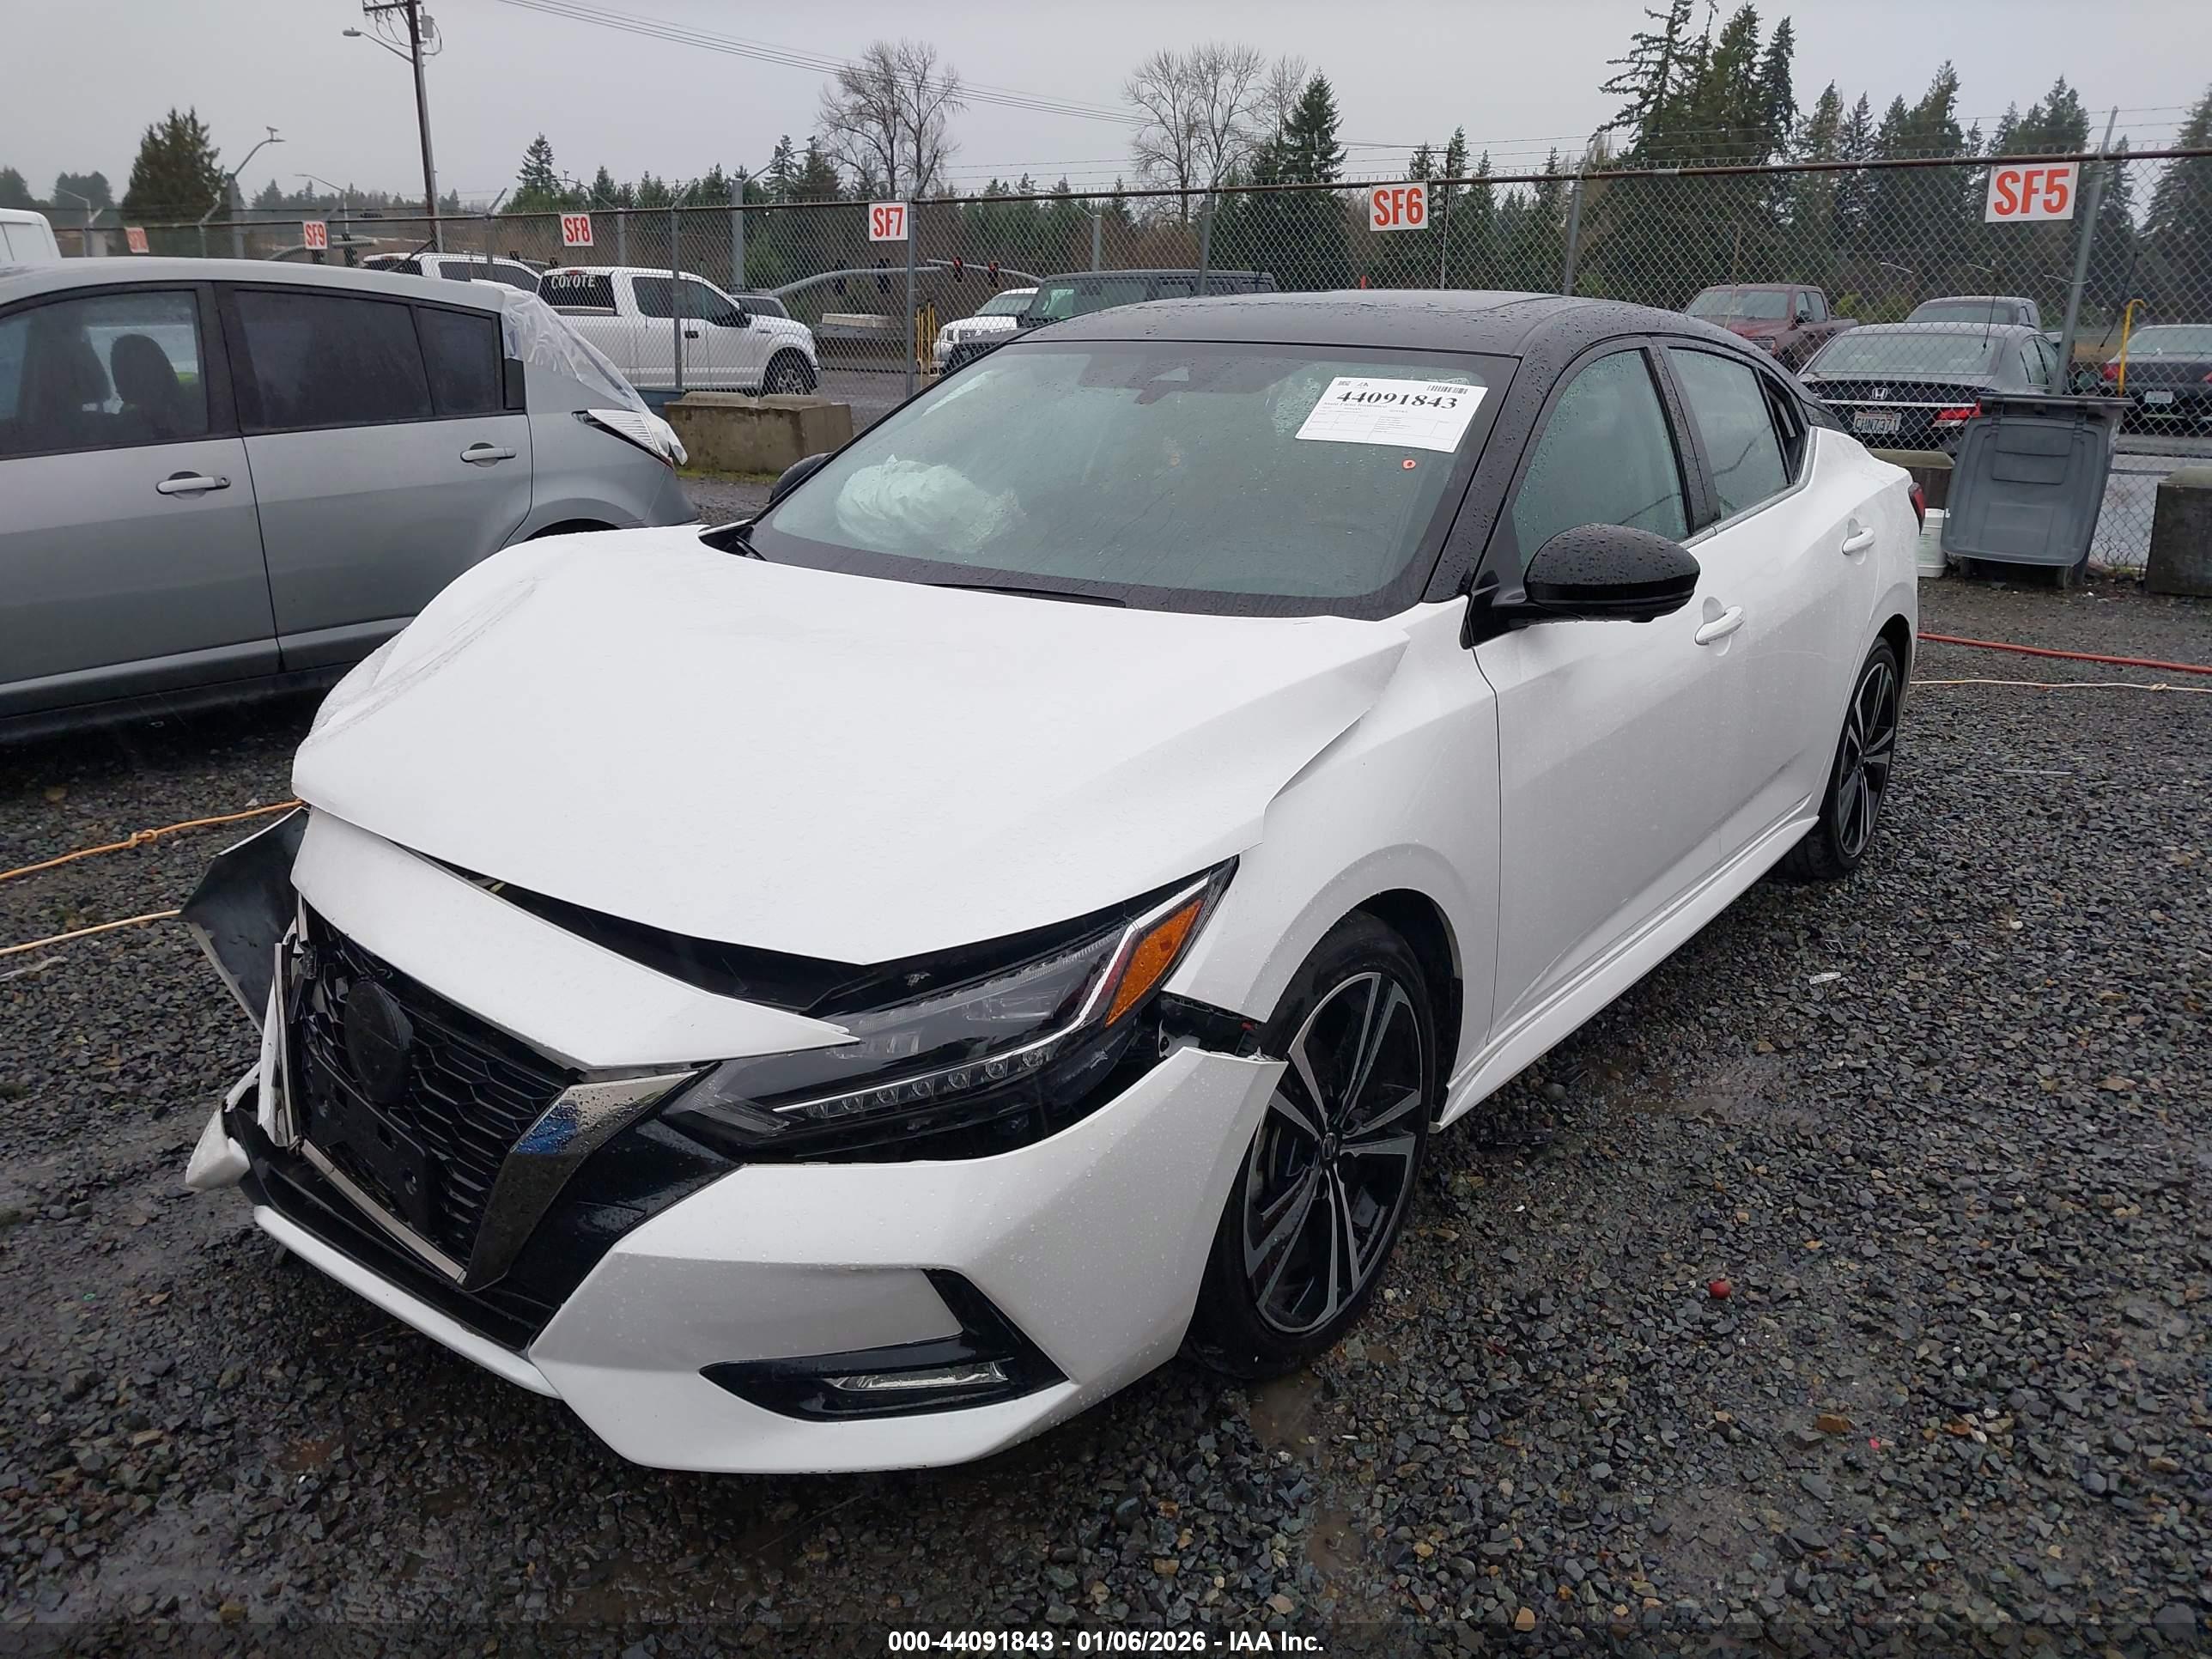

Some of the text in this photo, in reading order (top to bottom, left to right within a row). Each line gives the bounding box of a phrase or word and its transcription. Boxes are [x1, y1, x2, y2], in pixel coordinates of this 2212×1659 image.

[1993, 167, 2069, 216] SF5
[1373, 187, 1424, 227] SF6
[306, 224, 326, 246] SF9
[563, 216, 591, 243] SF8
[872, 206, 904, 238] SF7
[550, 275, 596, 290] COYOTE
[1336, 390, 1458, 410] 44091843
